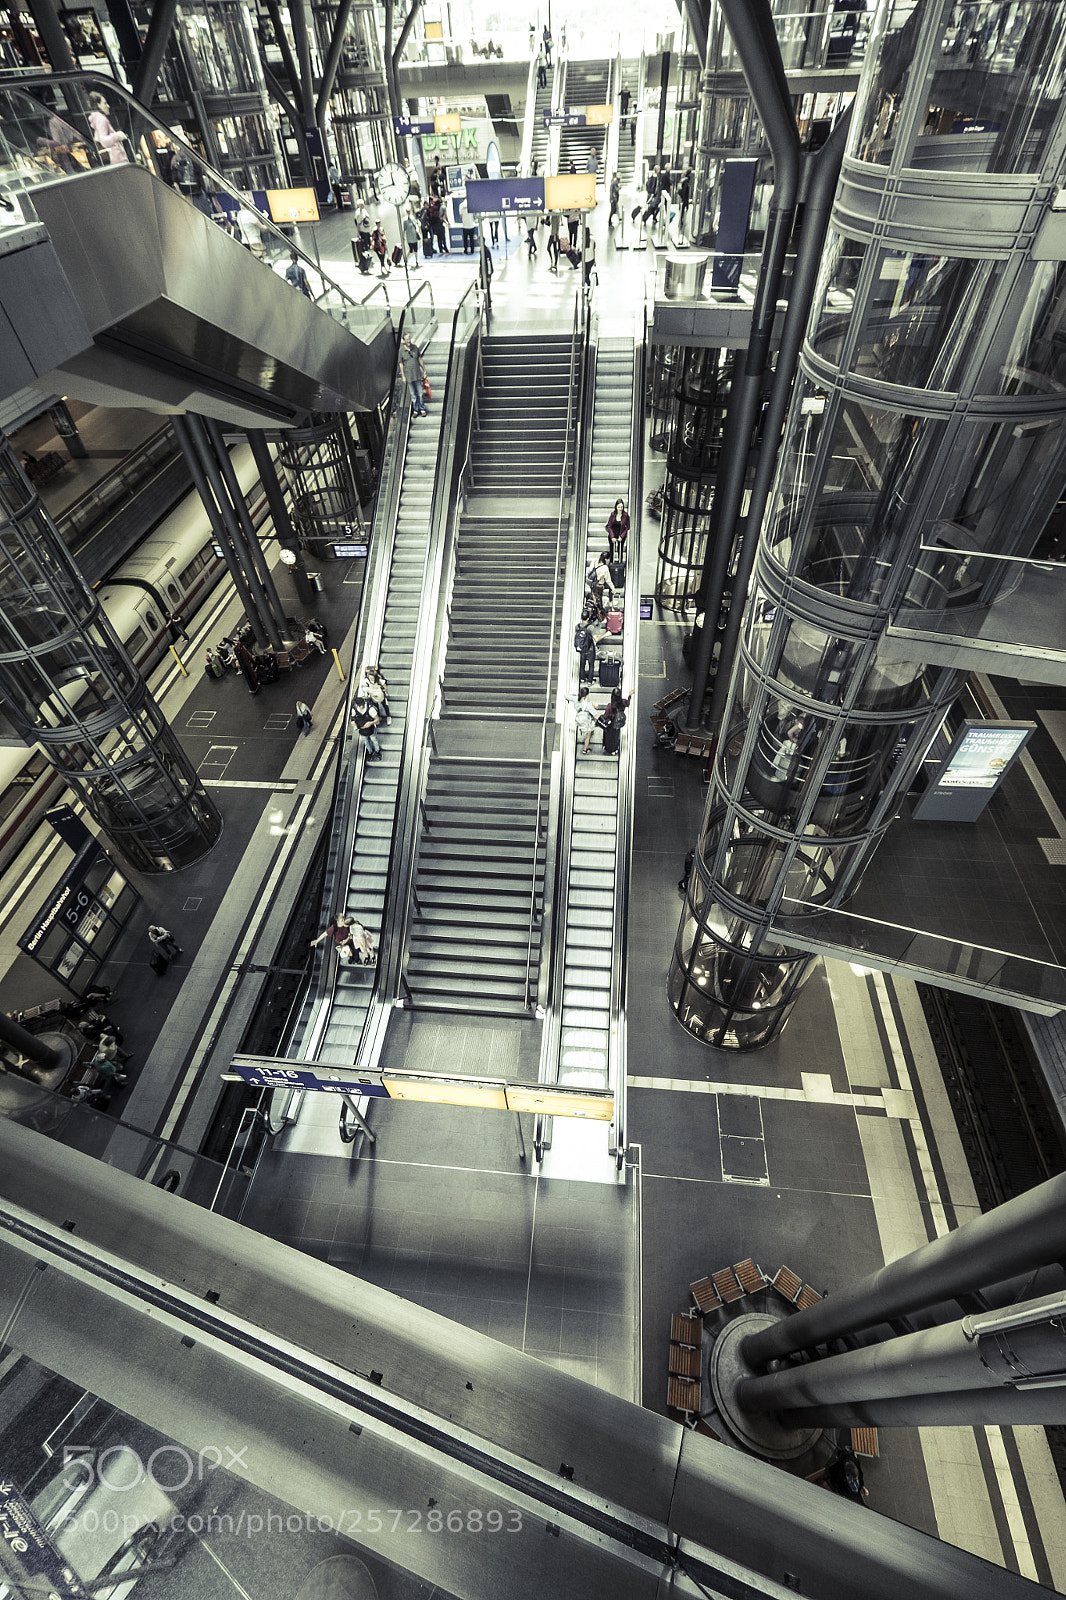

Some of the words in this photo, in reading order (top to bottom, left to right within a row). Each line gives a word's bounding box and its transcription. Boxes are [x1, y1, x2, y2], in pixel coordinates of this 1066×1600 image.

[421, 128, 477, 150] DEVK
[345, 525, 352, 535] 5
[959, 744, 1013, 754] GÜNSTIG
[66, 891, 89, 923] 5-6
[27, 929, 44, 951] Berlin
[40, 886, 72, 931] Hauptbahnhof
[255, 1067, 299, 1079] 11-16
